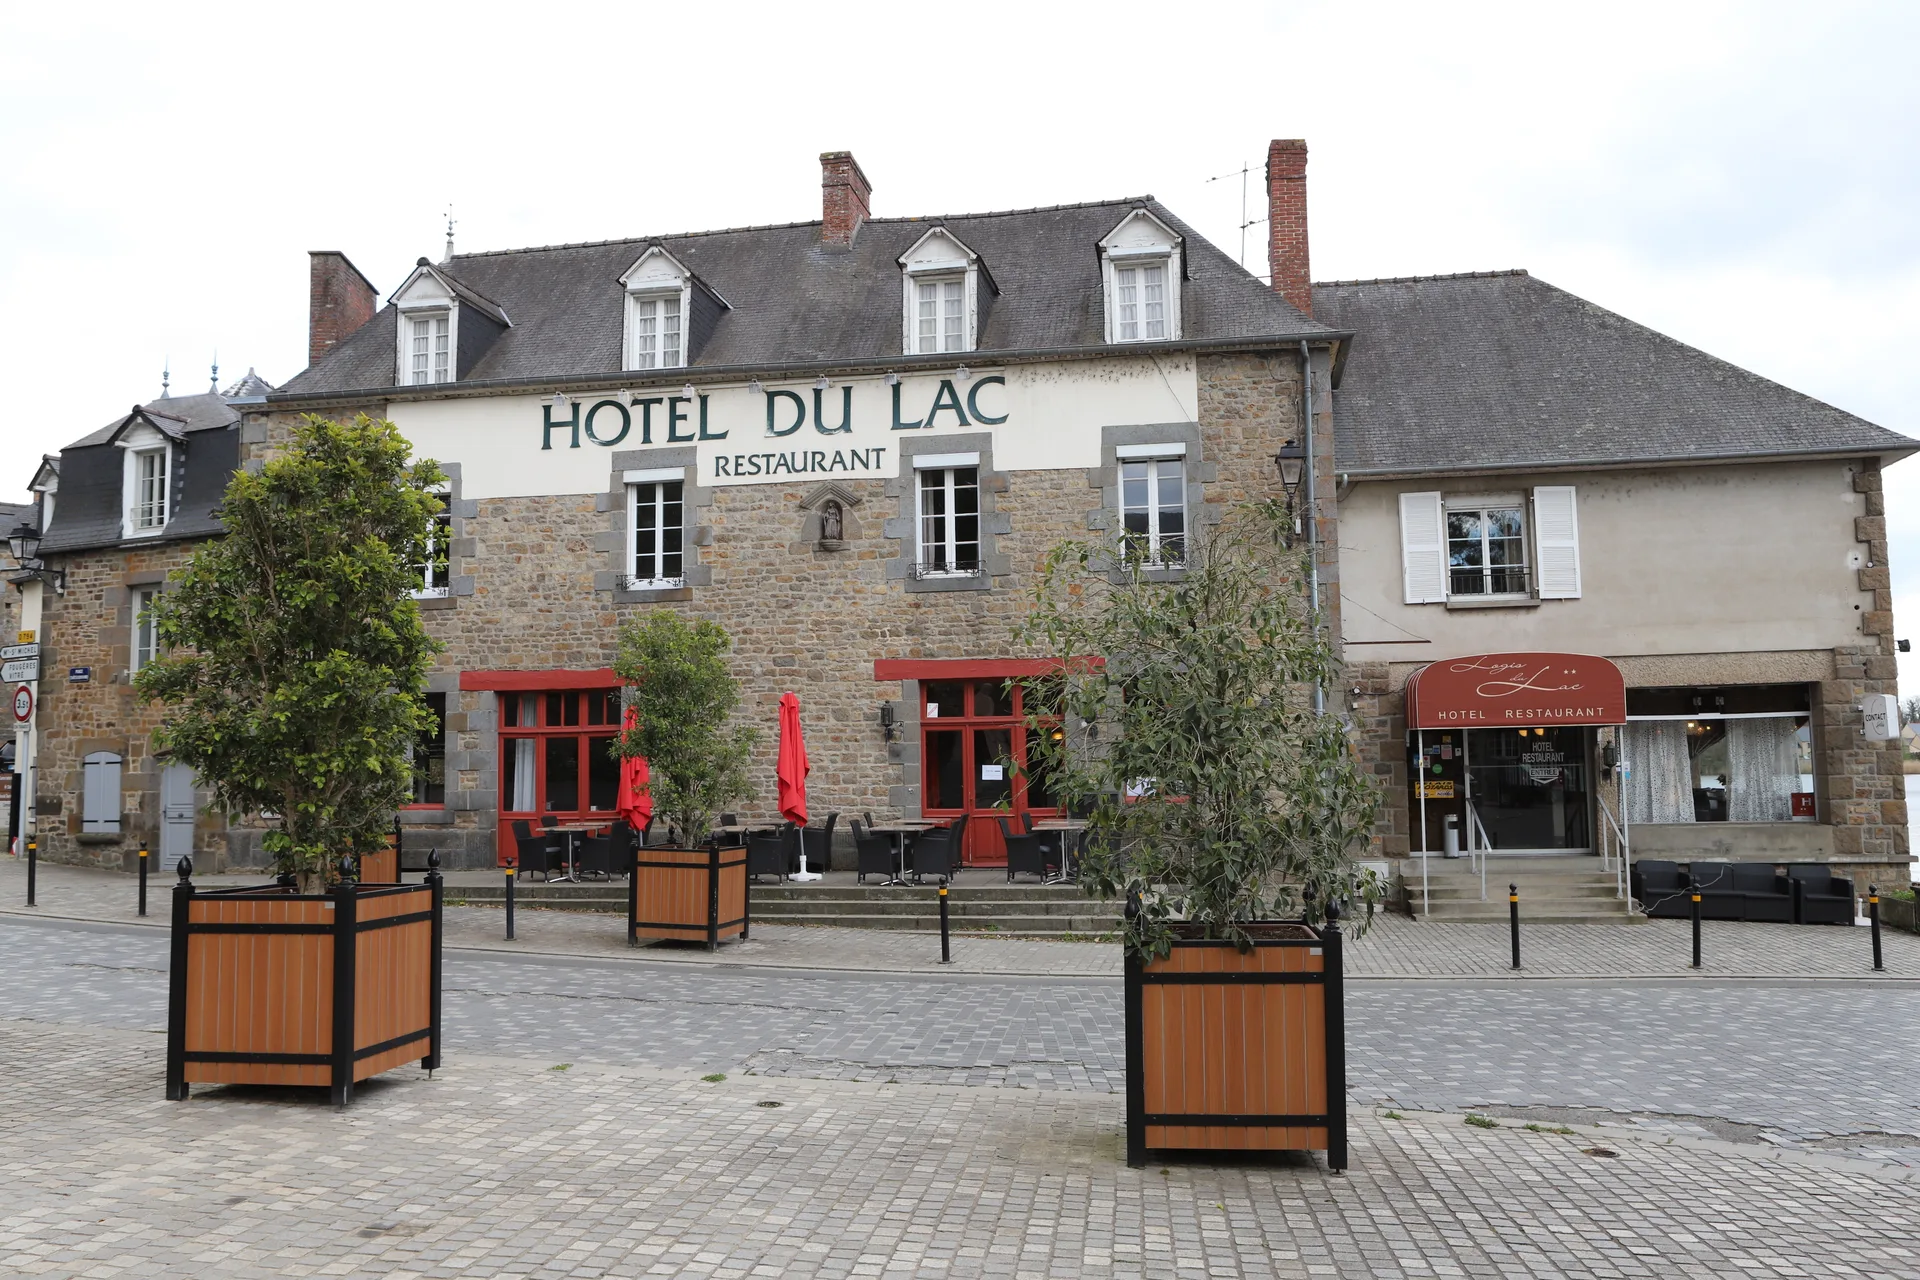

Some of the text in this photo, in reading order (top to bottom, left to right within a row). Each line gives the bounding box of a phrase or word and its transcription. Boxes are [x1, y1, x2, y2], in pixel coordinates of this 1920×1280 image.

[541, 375, 1009, 450] HOTEL DU LAC
[715, 447, 886, 477] RESTAURANT
[18, 646, 37, 655] MICHEL
[1450, 656, 1527, 674] Logis
[1476, 665, 1585, 697] Lac
[1510, 673, 1527, 681] du
[1438, 707, 1604, 720] HOTEL RESTAURANT
[1865, 712, 1886, 722] CONTACT
[1532, 741, 1554, 752] HOTEL
[1522, 752, 1564, 763] RESTAURANT
[1801, 797, 1811, 806] H
